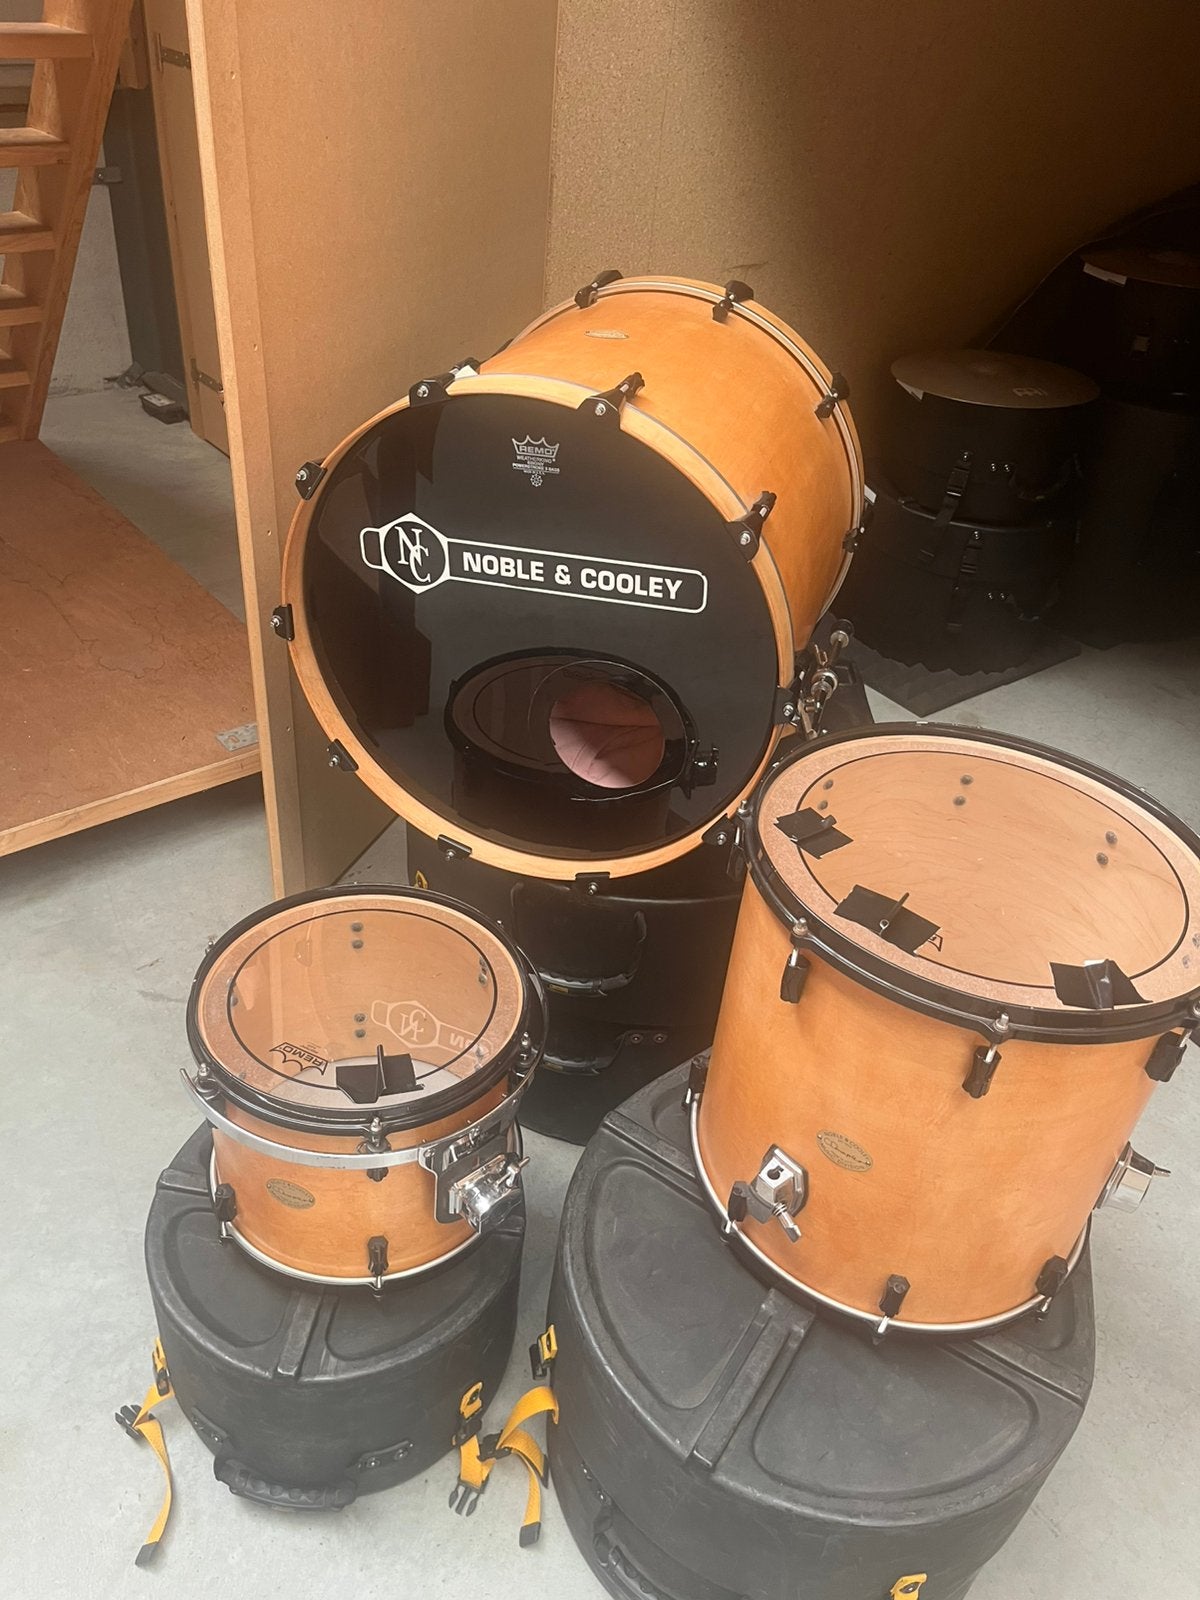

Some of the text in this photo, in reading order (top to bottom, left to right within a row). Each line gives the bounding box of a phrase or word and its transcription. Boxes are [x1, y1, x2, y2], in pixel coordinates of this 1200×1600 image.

[519, 445, 553, 455] REMO
[462, 551, 683, 600] NOBLE & COOLEY
[282, 1045, 324, 1067] REMO
